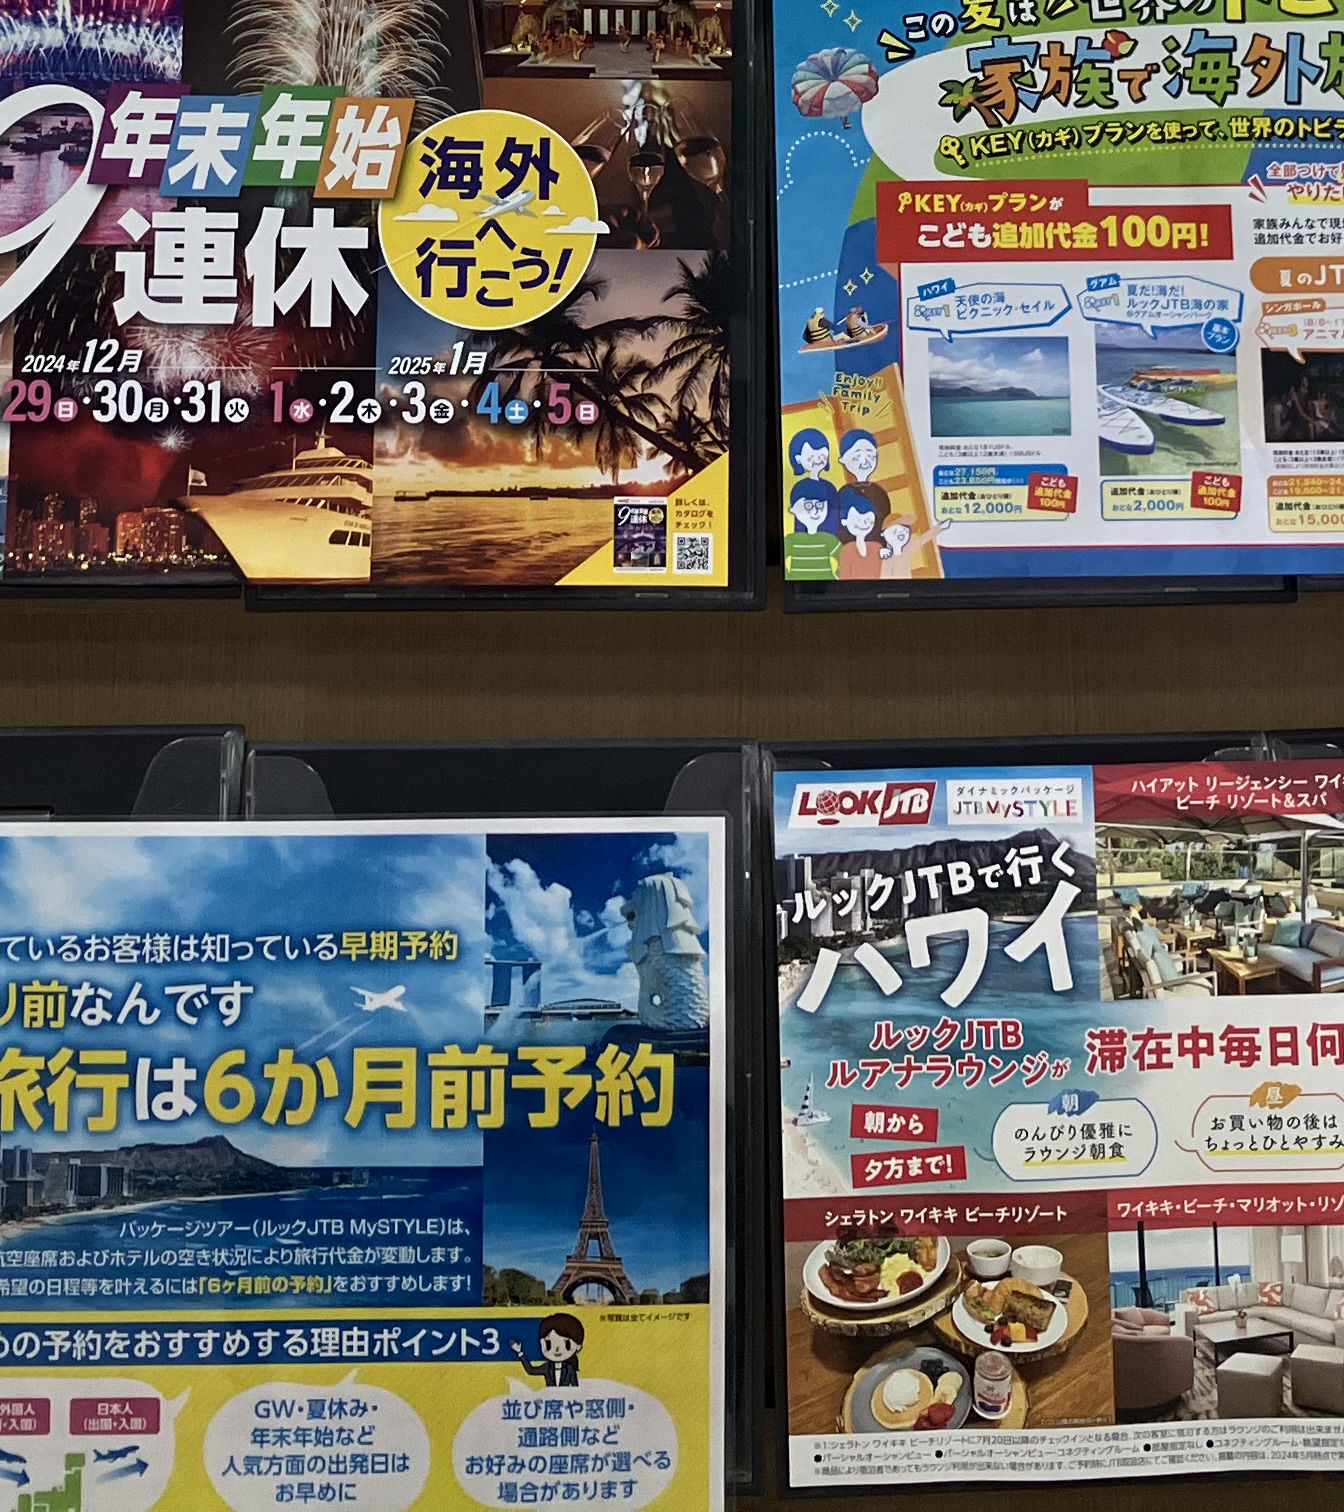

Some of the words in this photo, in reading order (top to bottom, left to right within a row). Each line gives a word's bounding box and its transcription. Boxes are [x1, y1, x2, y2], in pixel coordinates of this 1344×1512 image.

[101, 90, 402, 191] 年末年始
[917, 214, 1209, 249] こども追加代金100円!
[115, 206, 369, 328] 連休
[922, 281, 949, 297] ハワイ
[832, 387, 881, 403] Family
[841, 402, 870, 415] Trip
[1132, 777, 1198, 794] ハイアット
[1207, 773, 1308, 792] リージェンシー
[1176, 796, 1219, 810] ビーチ
[793, 842, 1080, 924] ルックJTBで行く
[797, 880, 1081, 1012] ハワイ
[871, 1018, 1023, 1050] ルックJTB
[826, 1057, 1069, 1088] ルアナラウンジが
[864, 1111, 924, 1134] 朝から
[1211, 1114, 1337, 1131] お買い物の後は
[1024, 1142, 1125, 1161] ラウンジ朝食
[1205, 1132, 1344, 1150] ちょっとひとやすみ
[864, 1158, 953, 1181] 夕方まで!
[825, 1208, 894, 1227] シェラトン
[901, 1207, 958, 1223] ワイキキ
[965, 1206, 1067, 1222] ビーチリゾート
[97, 1402, 133, 1416] 日本人
[251, 1427, 375, 1446] 年末年始など
[518, 1427, 619, 1447] 通路側など
[222, 1454, 409, 1475] 人気方面の出発日は
[465, 1453, 671, 1475] お好みの座席が選べる
[275, 1484, 356, 1503] お早めに
[498, 1480, 638, 1501] 場合があります
